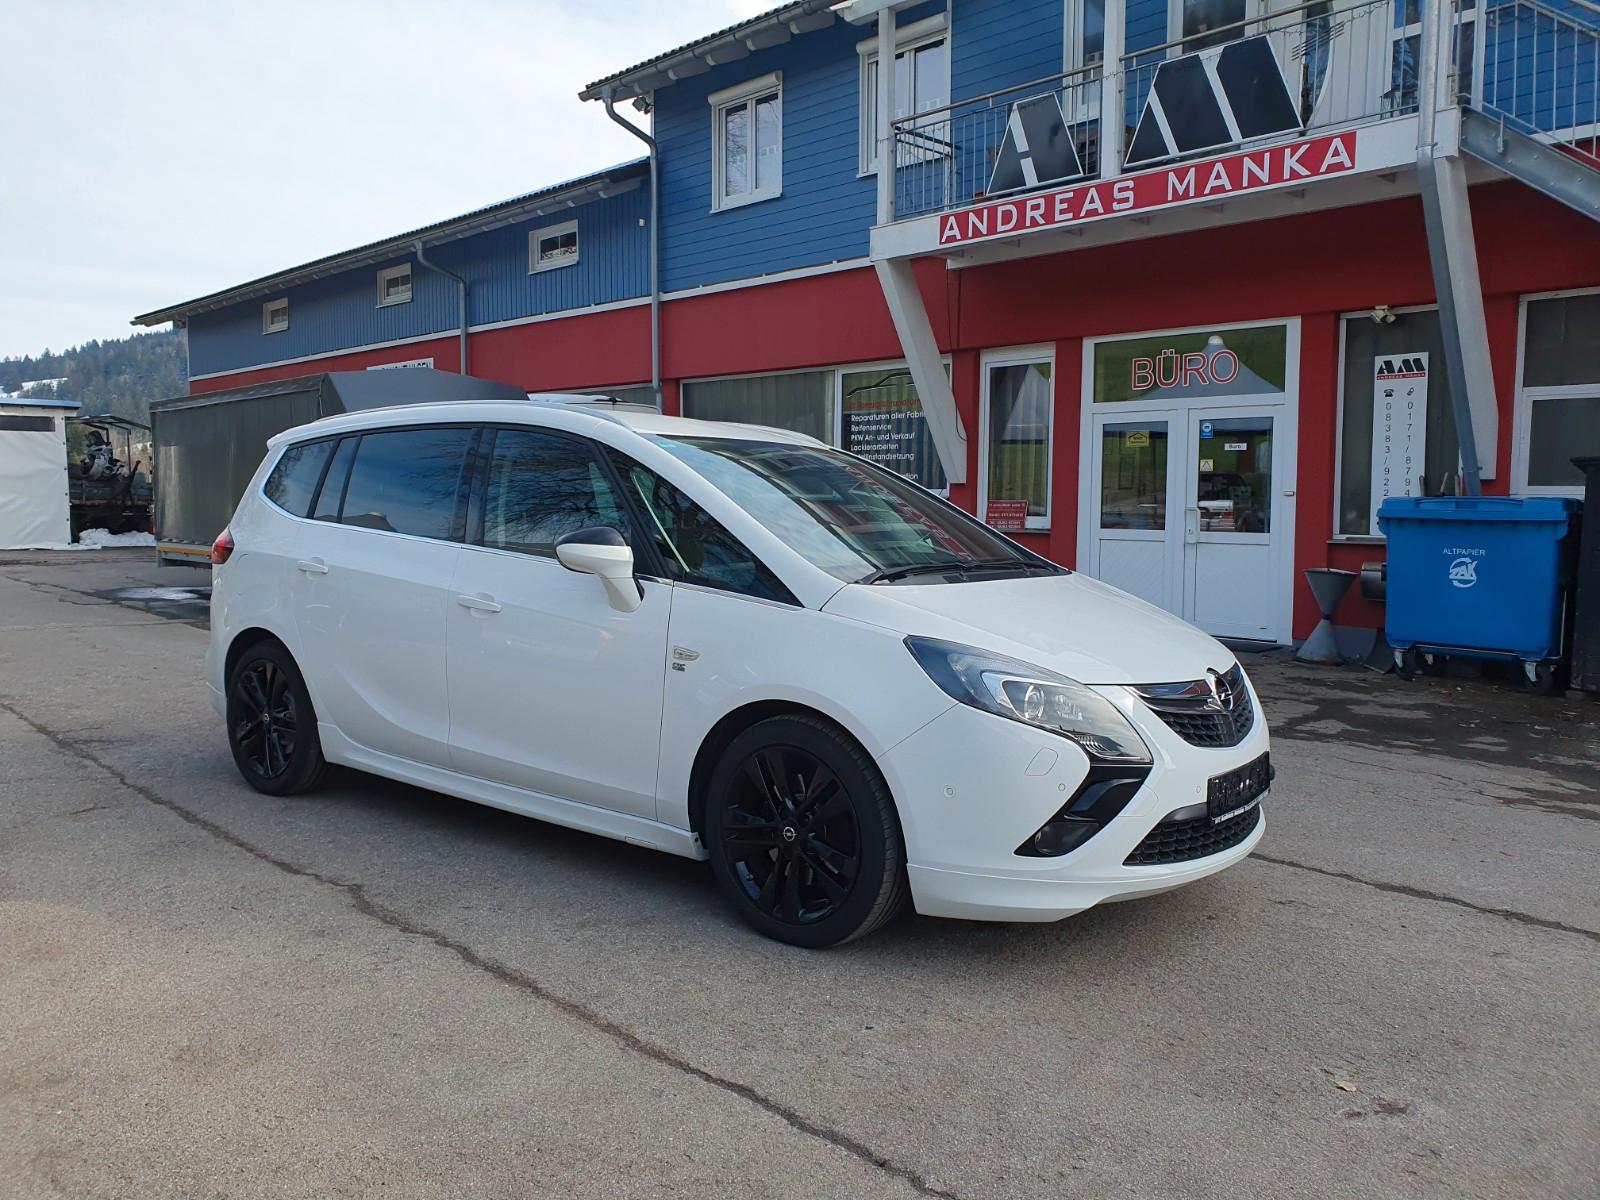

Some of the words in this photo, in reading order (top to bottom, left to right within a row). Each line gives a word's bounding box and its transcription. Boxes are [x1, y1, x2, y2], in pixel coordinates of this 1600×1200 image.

[941, 180, 1135, 244] ANDREAS
[1167, 137, 1353, 200] MANKA
[1131, 348, 1240, 390] BÜRO
[851, 414, 890, 422] Reparaturen
[890, 432, 916, 440] Verkauf
[1442, 548, 1486, 556] ALTPAPIER
[1449, 560, 1478, 581] ZAK
